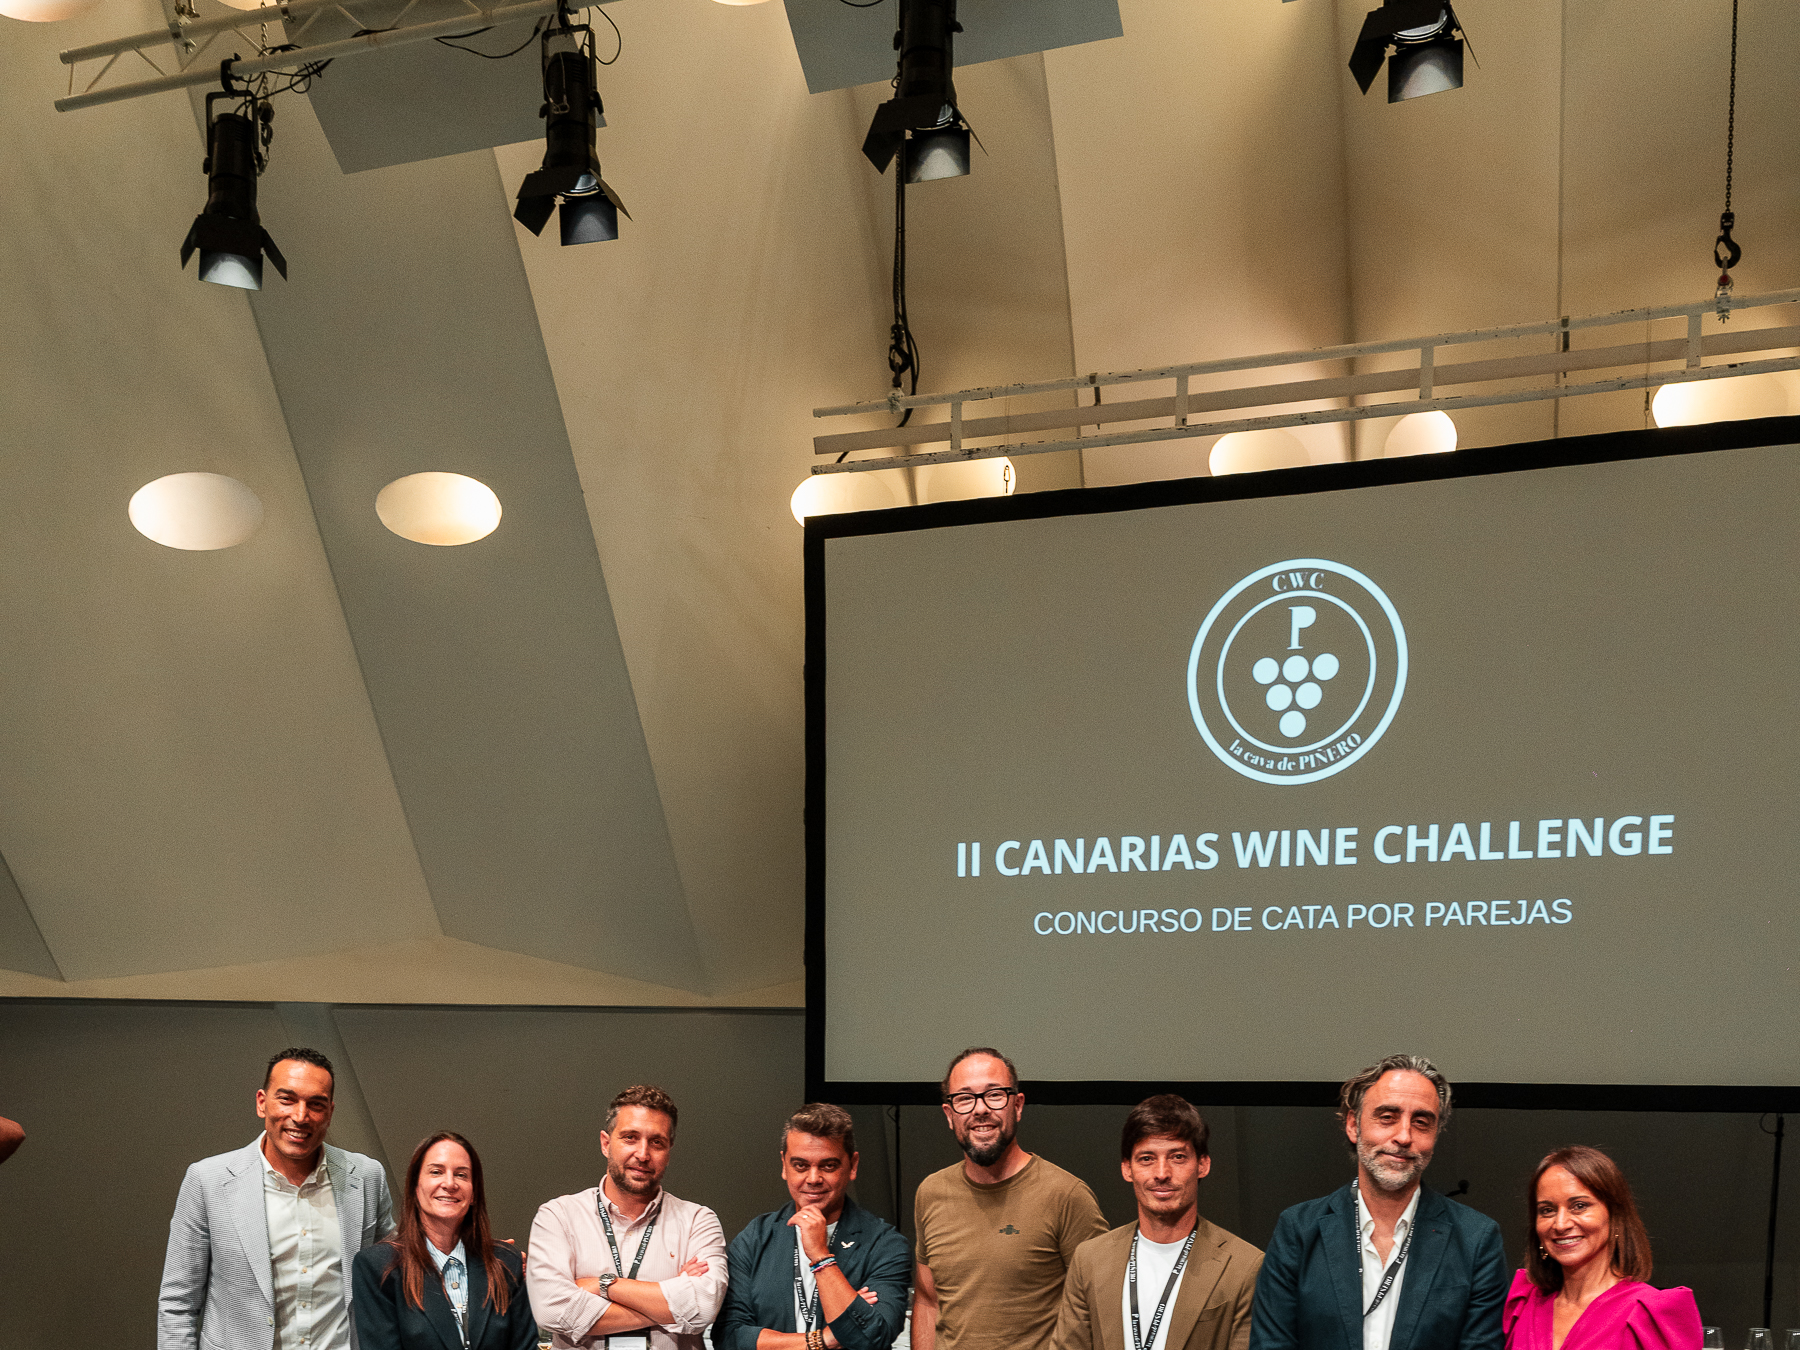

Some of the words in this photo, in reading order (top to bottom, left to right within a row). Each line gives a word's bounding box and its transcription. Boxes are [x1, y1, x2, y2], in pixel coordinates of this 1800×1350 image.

[1271, 571, 1325, 592] CWC
[1286, 605, 1317, 650] P
[1228, 738, 1244, 757] la
[1243, 751, 1275, 770] cava
[1276, 756, 1297, 771] de
[1298, 732, 1362, 771] PIÑERO
[956, 842, 981, 878] II
[994, 833, 1220, 877] CANARIAS
[1231, 826, 1359, 869] WINE
[1373, 814, 1676, 865] CHALLENGE
[1033, 908, 1203, 936] CONCURSO
[1211, 907, 1253, 932] DE
[1261, 904, 1340, 931] CATA
[1346, 902, 1415, 929] POR
[1424, 898, 1573, 927] PAREJAS
